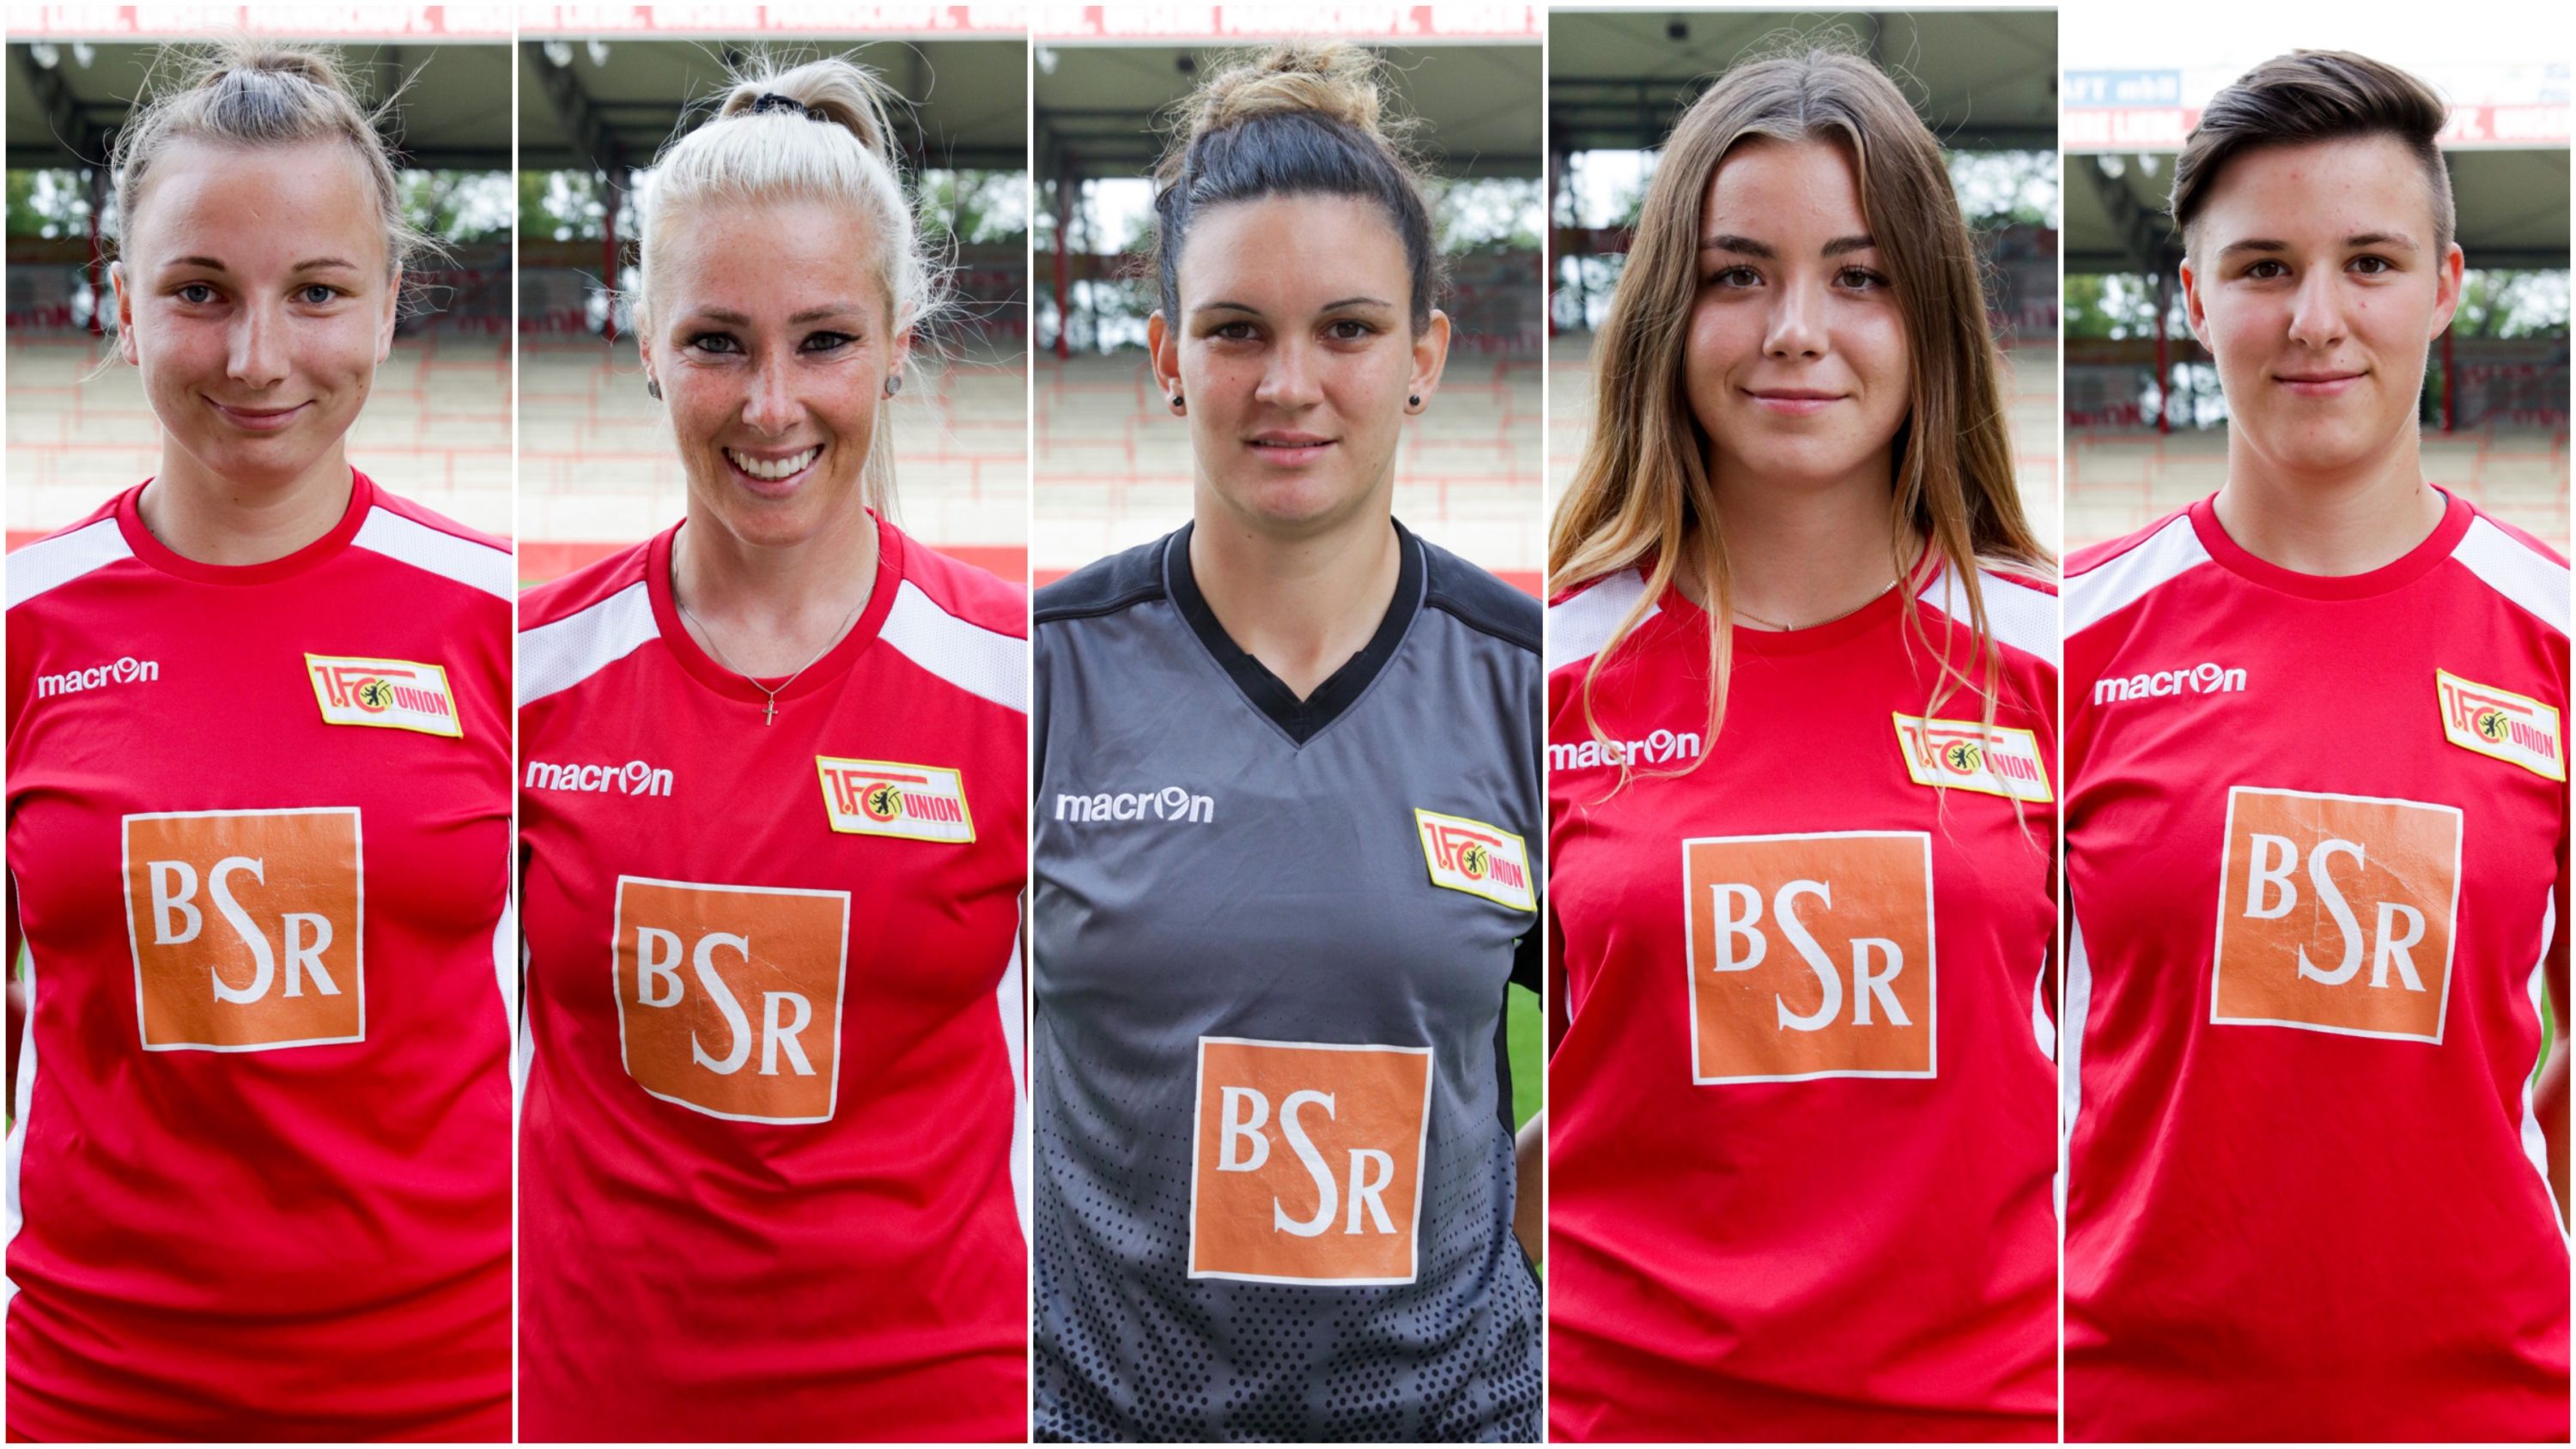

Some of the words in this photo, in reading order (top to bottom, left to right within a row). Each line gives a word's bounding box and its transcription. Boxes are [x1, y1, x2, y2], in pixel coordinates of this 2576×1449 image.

[38, 657, 159, 698] macron
[2095, 663, 2246, 706] macron
[393, 686, 450, 716] UNION
[1548, 729, 1700, 772] macron
[2510, 720, 2555, 760] UNION
[526, 760, 673, 797] macron
[903, 792, 963, 822] UNION
[1054, 785, 1215, 823] macron
[147, 856, 342, 1005] BSR
[2243, 833, 2427, 992] BSR
[1710, 879, 1914, 1032] BSR
[636, 925, 817, 1076] BSR
[1216, 1085, 1398, 1238] BSR
